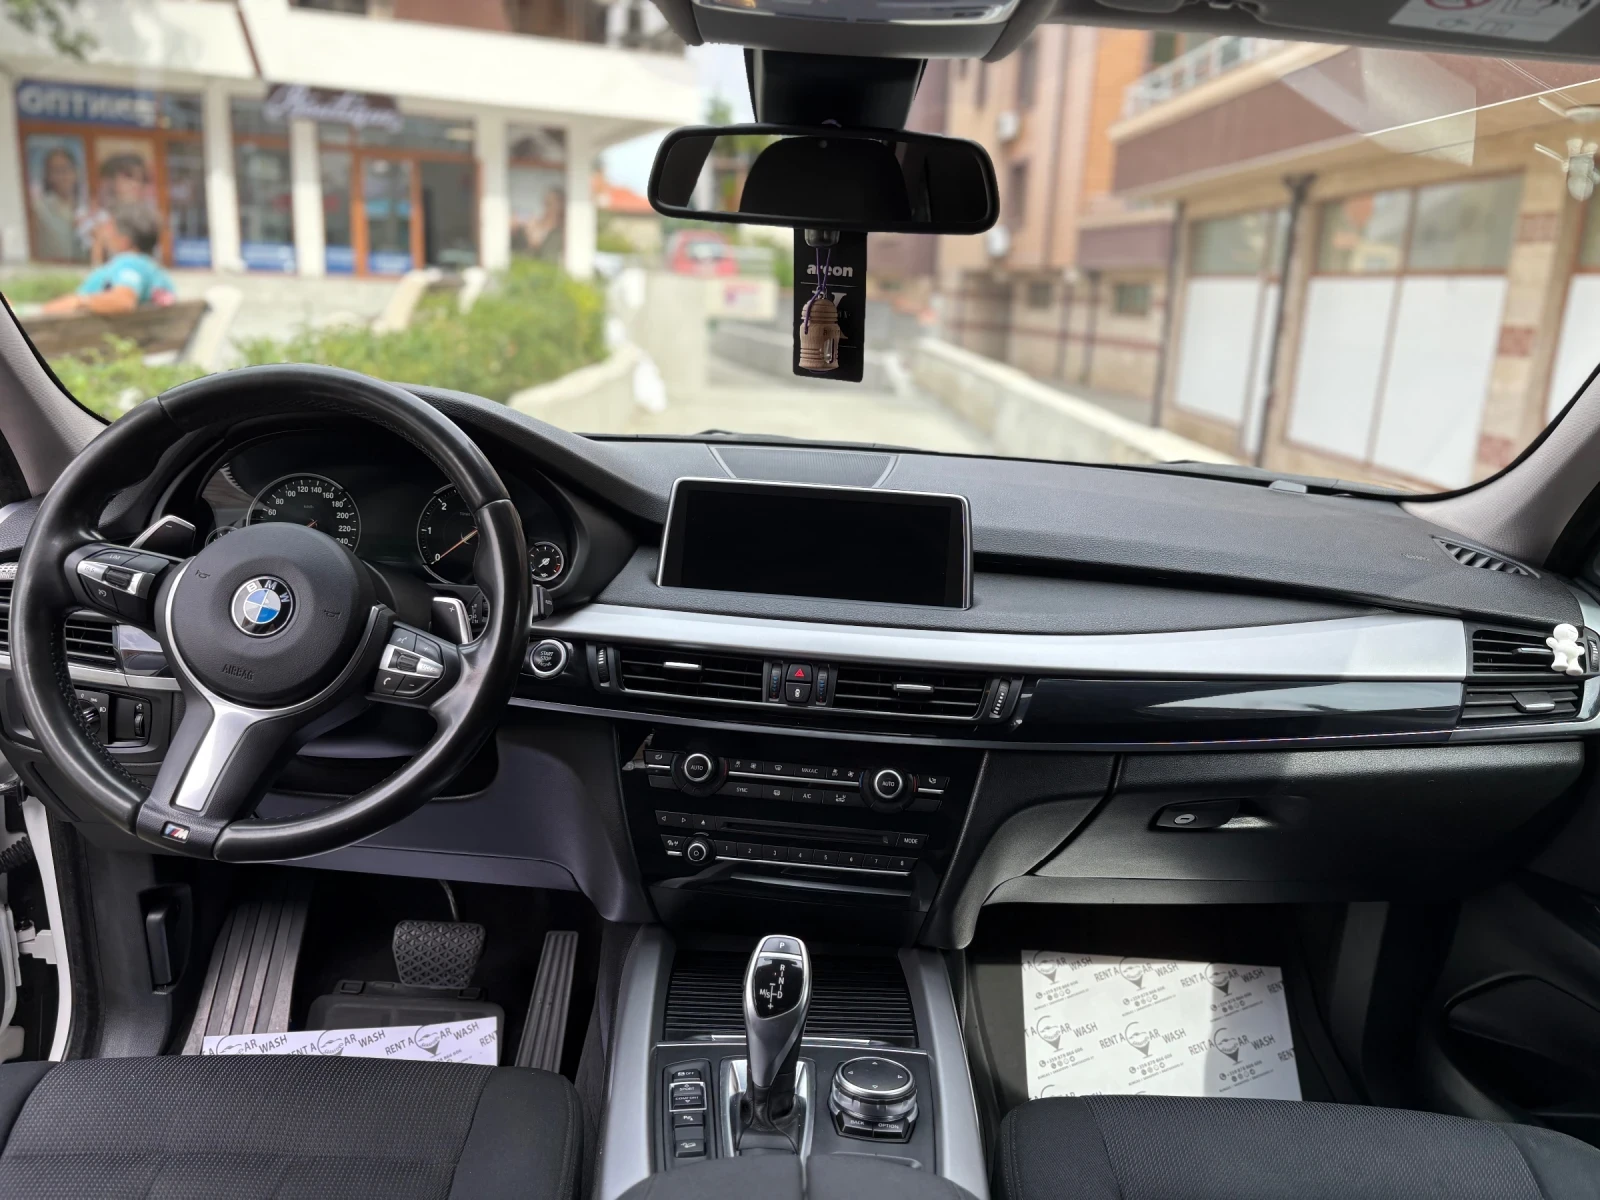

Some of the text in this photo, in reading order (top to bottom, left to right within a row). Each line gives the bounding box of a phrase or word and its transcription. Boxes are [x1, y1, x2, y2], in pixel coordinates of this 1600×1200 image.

[806, 263, 854, 278] areon
[246, 579, 290, 603] BMW
[222, 664, 254, 680] AIRBAG
[1068, 956, 1093, 972] WASH
[1094, 968, 1112, 982] RENT
[1113, 966, 1120, 976] A
[1154, 962, 1179, 977] WASH
[1180, 974, 1199, 988] RENT
[1240, 968, 1266, 984] WASH
[760, 988, 770, 998] M/S
[384, 1039, 407, 1056] RENT
[407, 1036, 414, 1046] A
[452, 1022, 480, 1041] WASH
[1030, 1026, 1037, 1036] A
[1072, 1022, 1098, 1038] WASH
[1099, 1034, 1118, 1050] RENT
[1118, 1032, 1126, 1043] A
[1162, 1028, 1186, 1044] WASH
[258, 1034, 288, 1053] WASH
[310, 1042, 318, 1052] A
[358, 1030, 386, 1048] WASH
[1188, 1043, 1208, 1056] RENT
[1208, 1038, 1215, 1049] A
[1250, 1034, 1276, 1050] WASH
